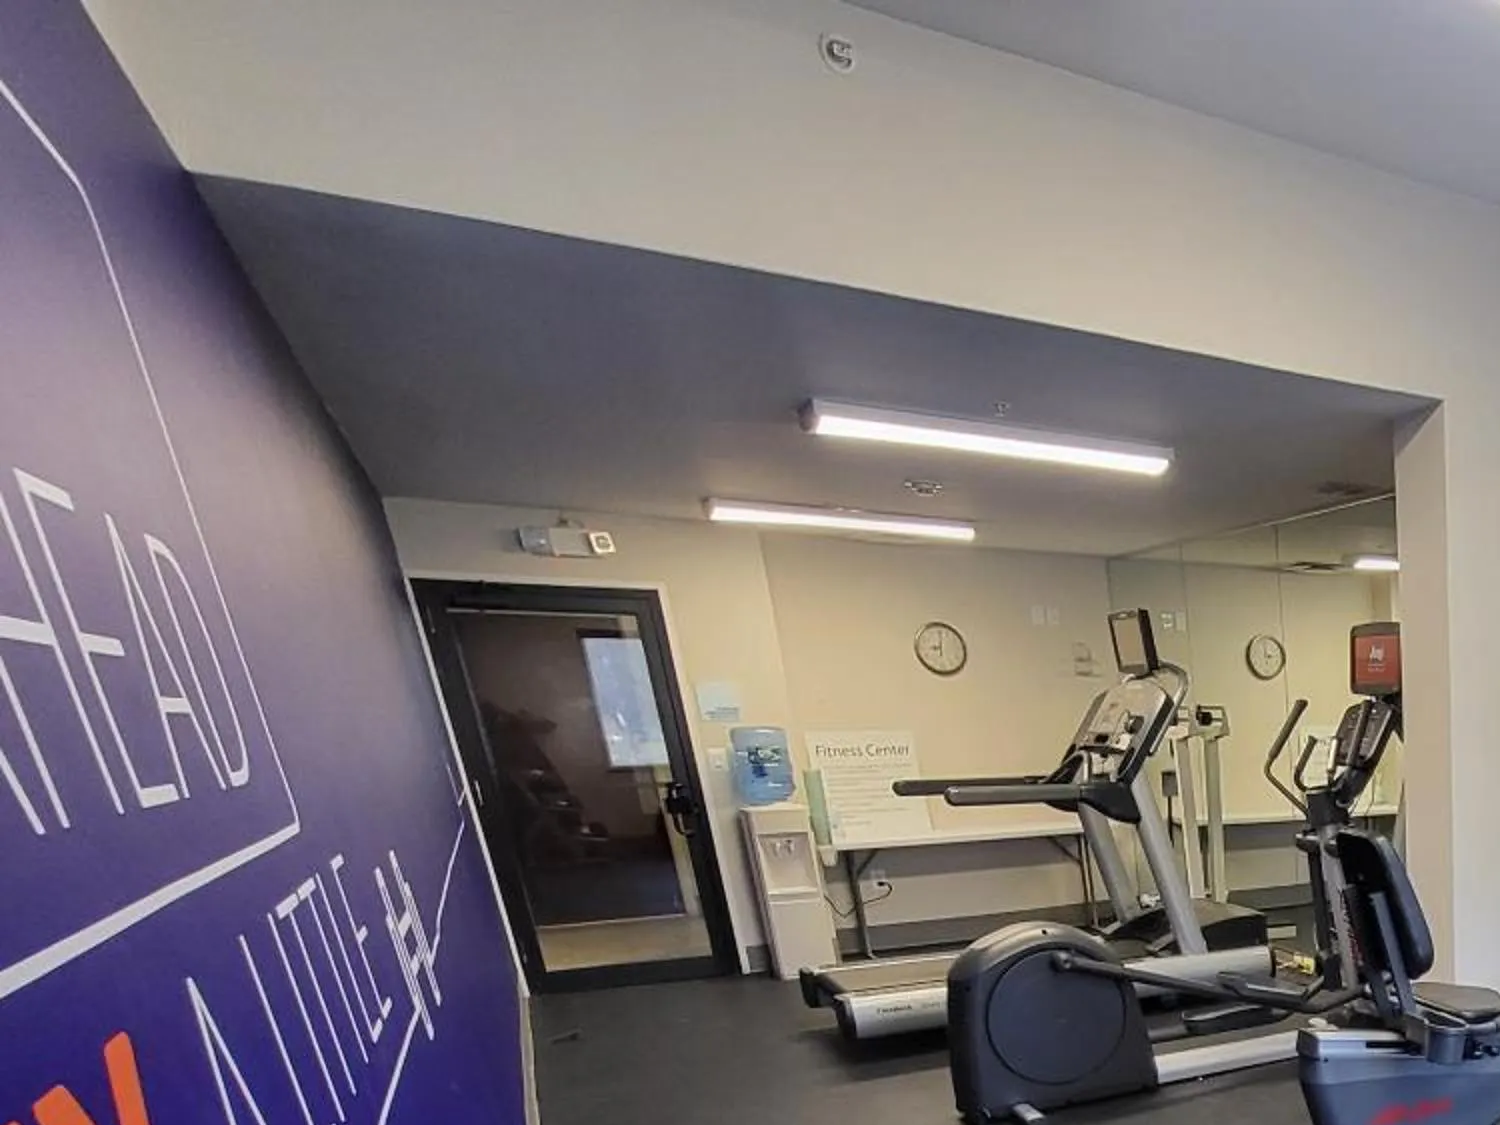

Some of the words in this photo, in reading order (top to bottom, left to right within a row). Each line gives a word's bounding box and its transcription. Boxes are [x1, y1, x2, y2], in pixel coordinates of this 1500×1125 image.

[0, 467, 249, 834] HEAD
[815, 744, 863, 757] Fitness
[865, 743, 909, 757] Center
